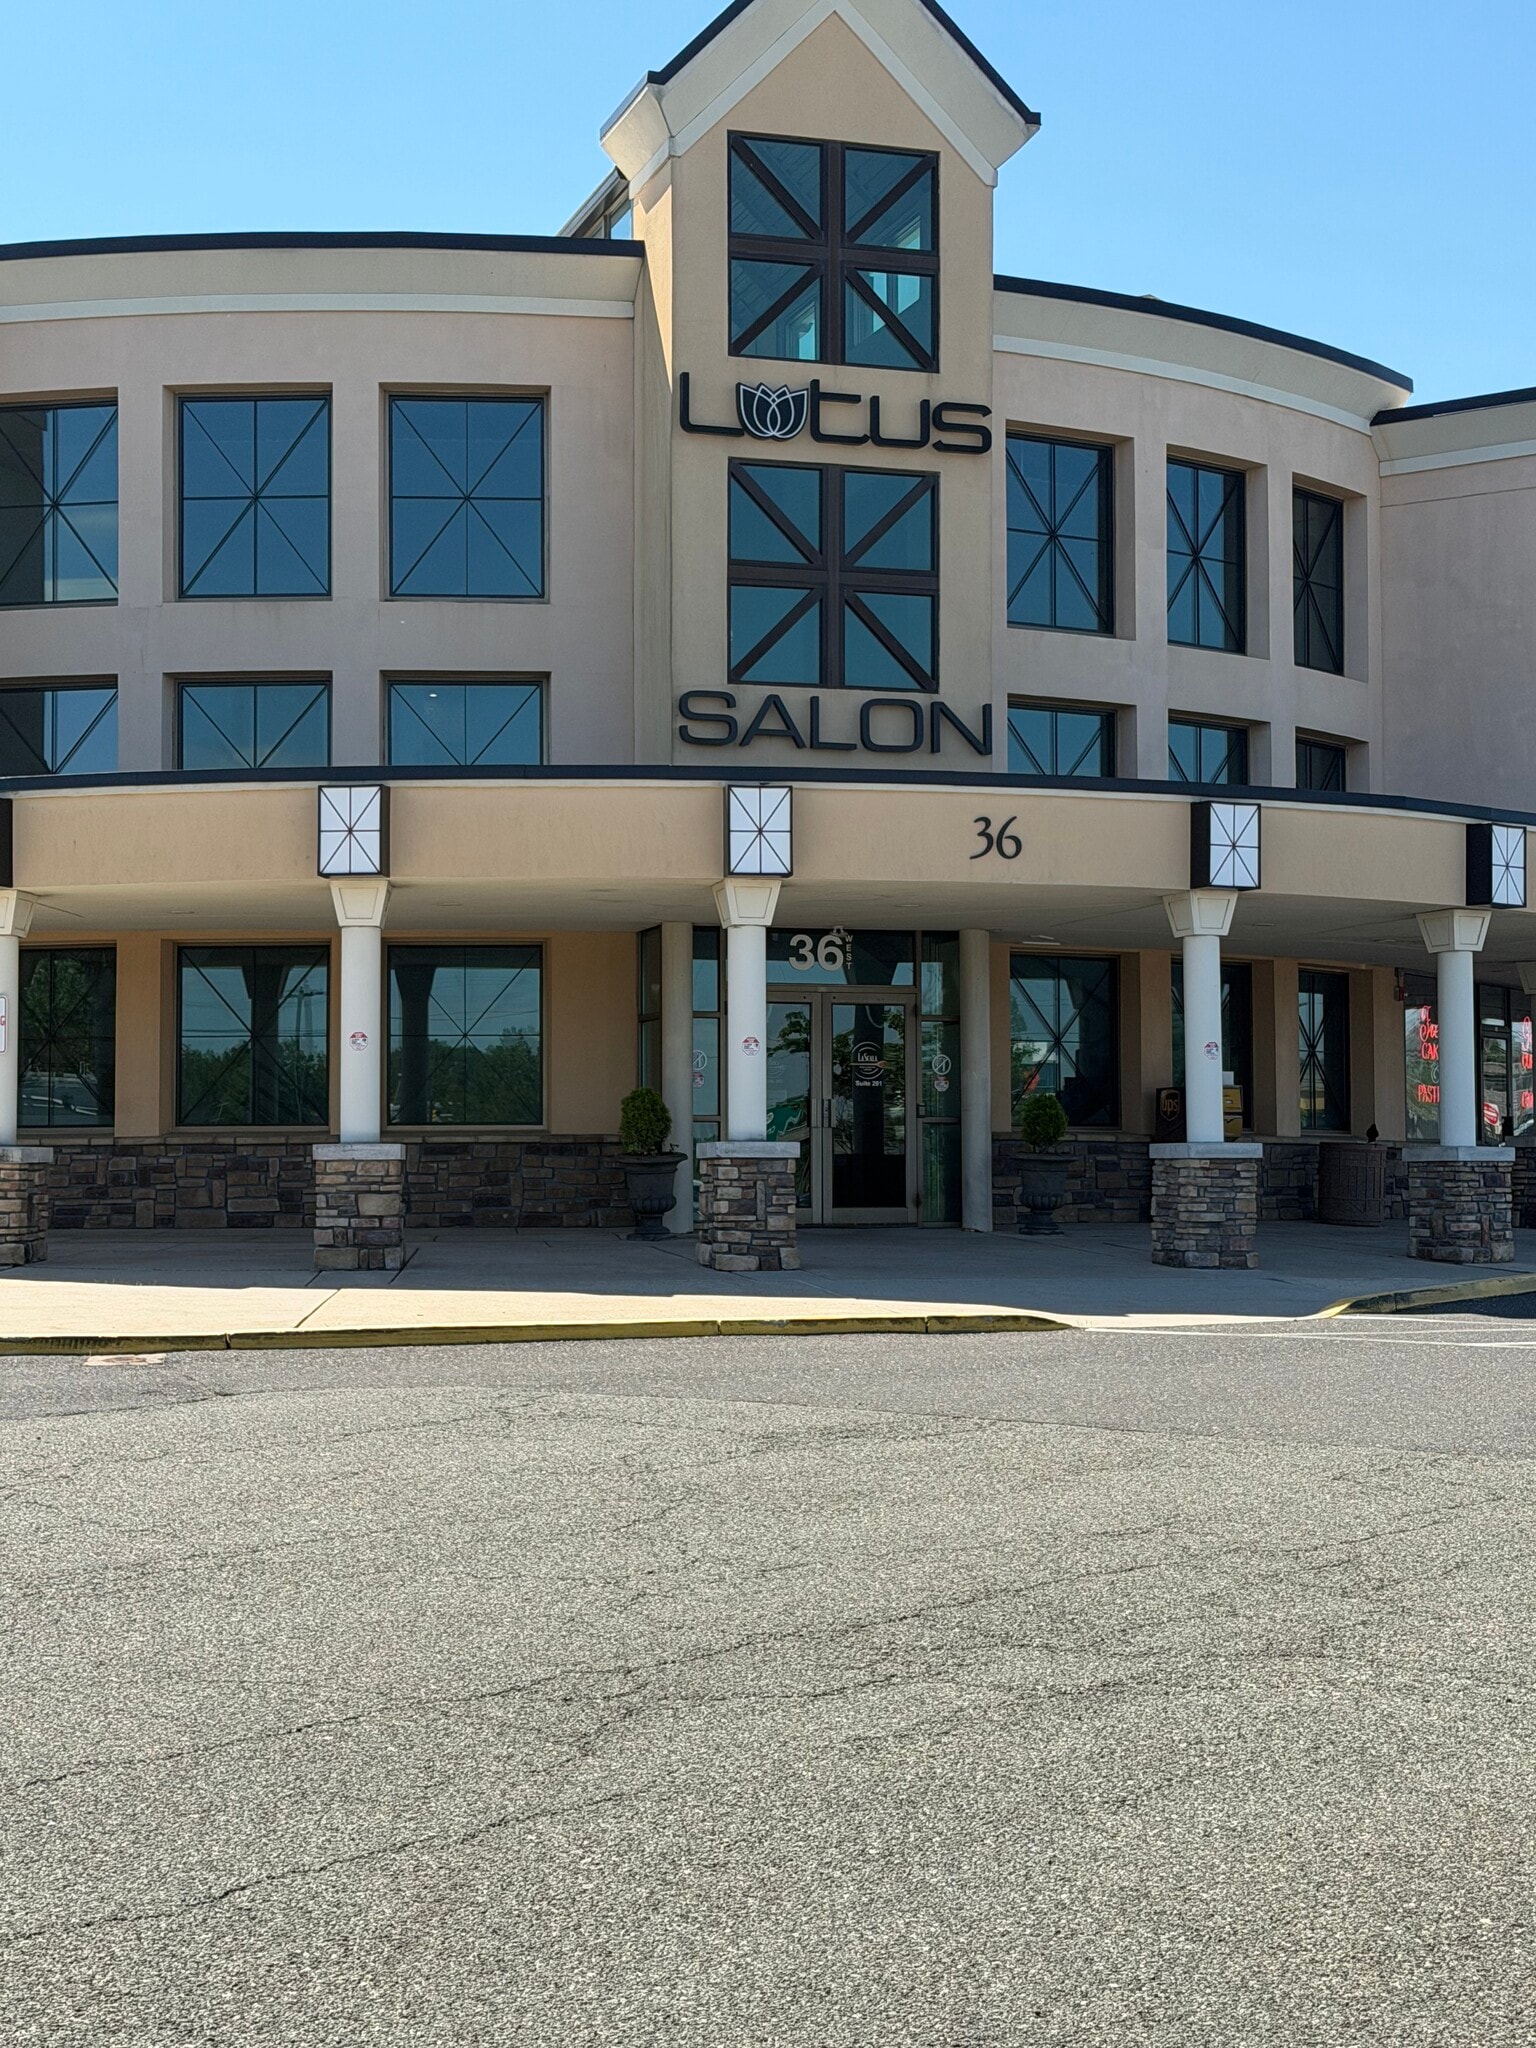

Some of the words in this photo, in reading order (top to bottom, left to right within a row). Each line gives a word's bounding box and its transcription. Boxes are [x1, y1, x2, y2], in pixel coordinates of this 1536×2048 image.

[679, 690, 992, 756] SALON
[969, 816, 1022, 860] 36
[789, 934, 844, 971] 36
[845, 935, 853, 970] WEST
[1161, 1098, 1178, 1116] ups
